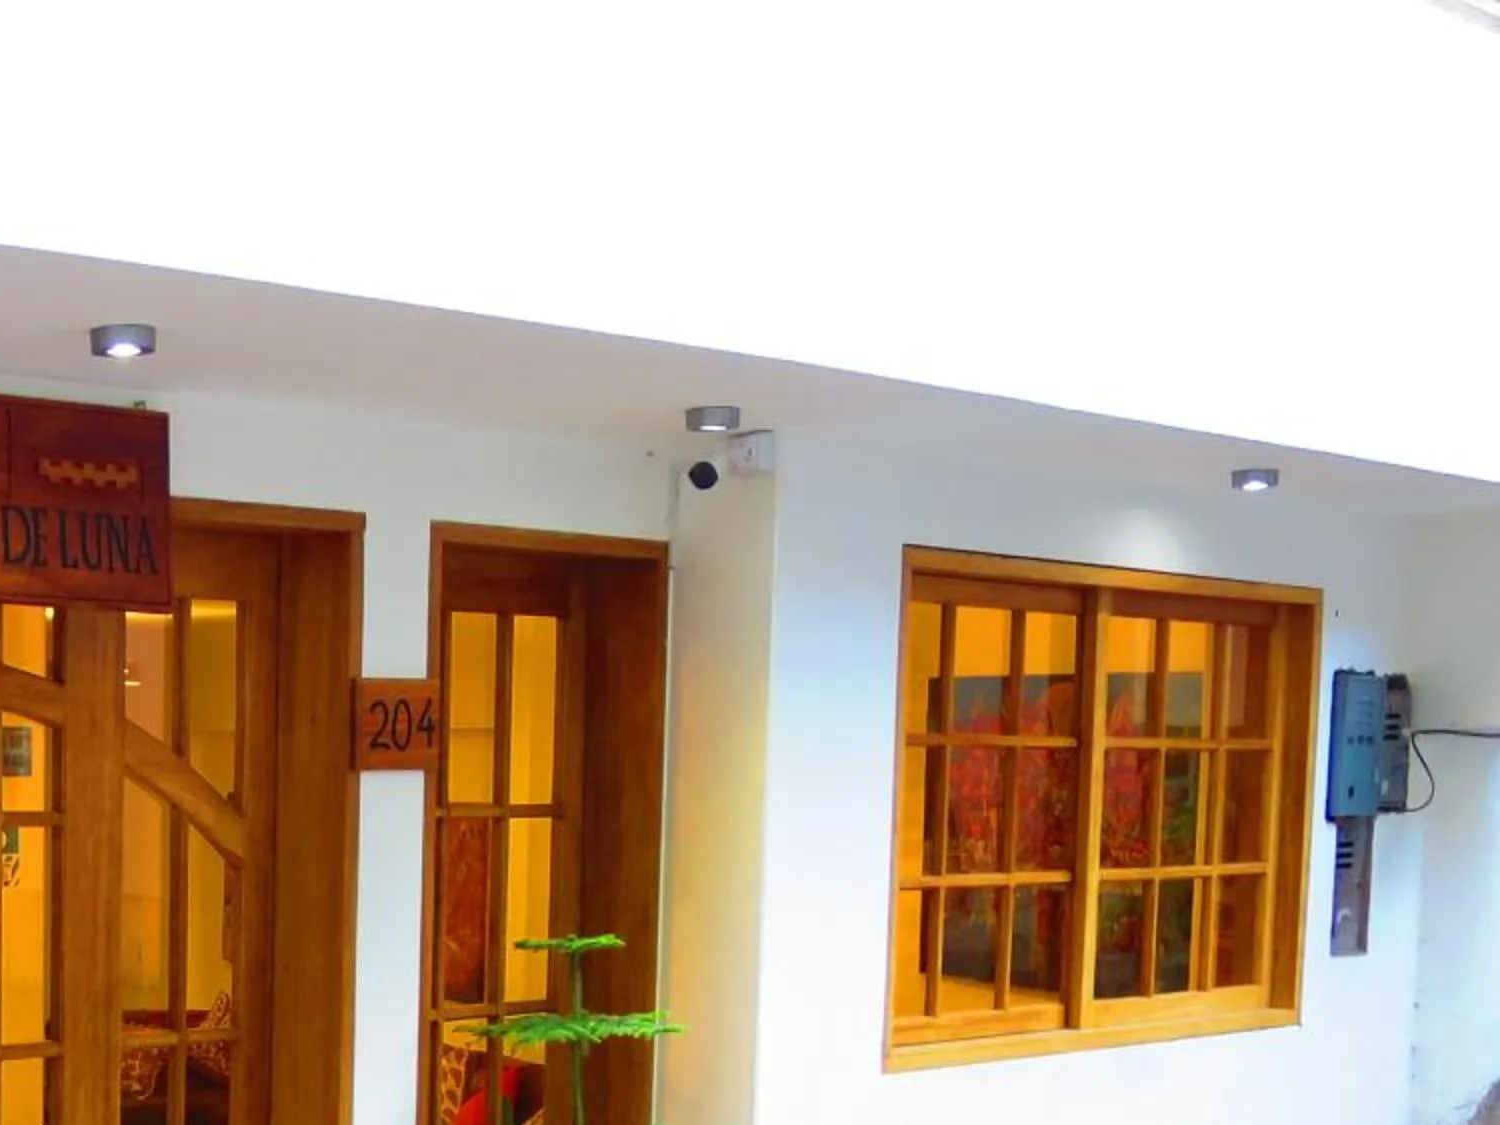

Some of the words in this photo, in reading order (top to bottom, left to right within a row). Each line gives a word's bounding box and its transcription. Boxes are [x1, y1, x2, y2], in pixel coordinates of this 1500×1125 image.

[0, 505, 49, 567] DE
[57, 509, 160, 576] LUNA
[368, 697, 435, 752] 204
